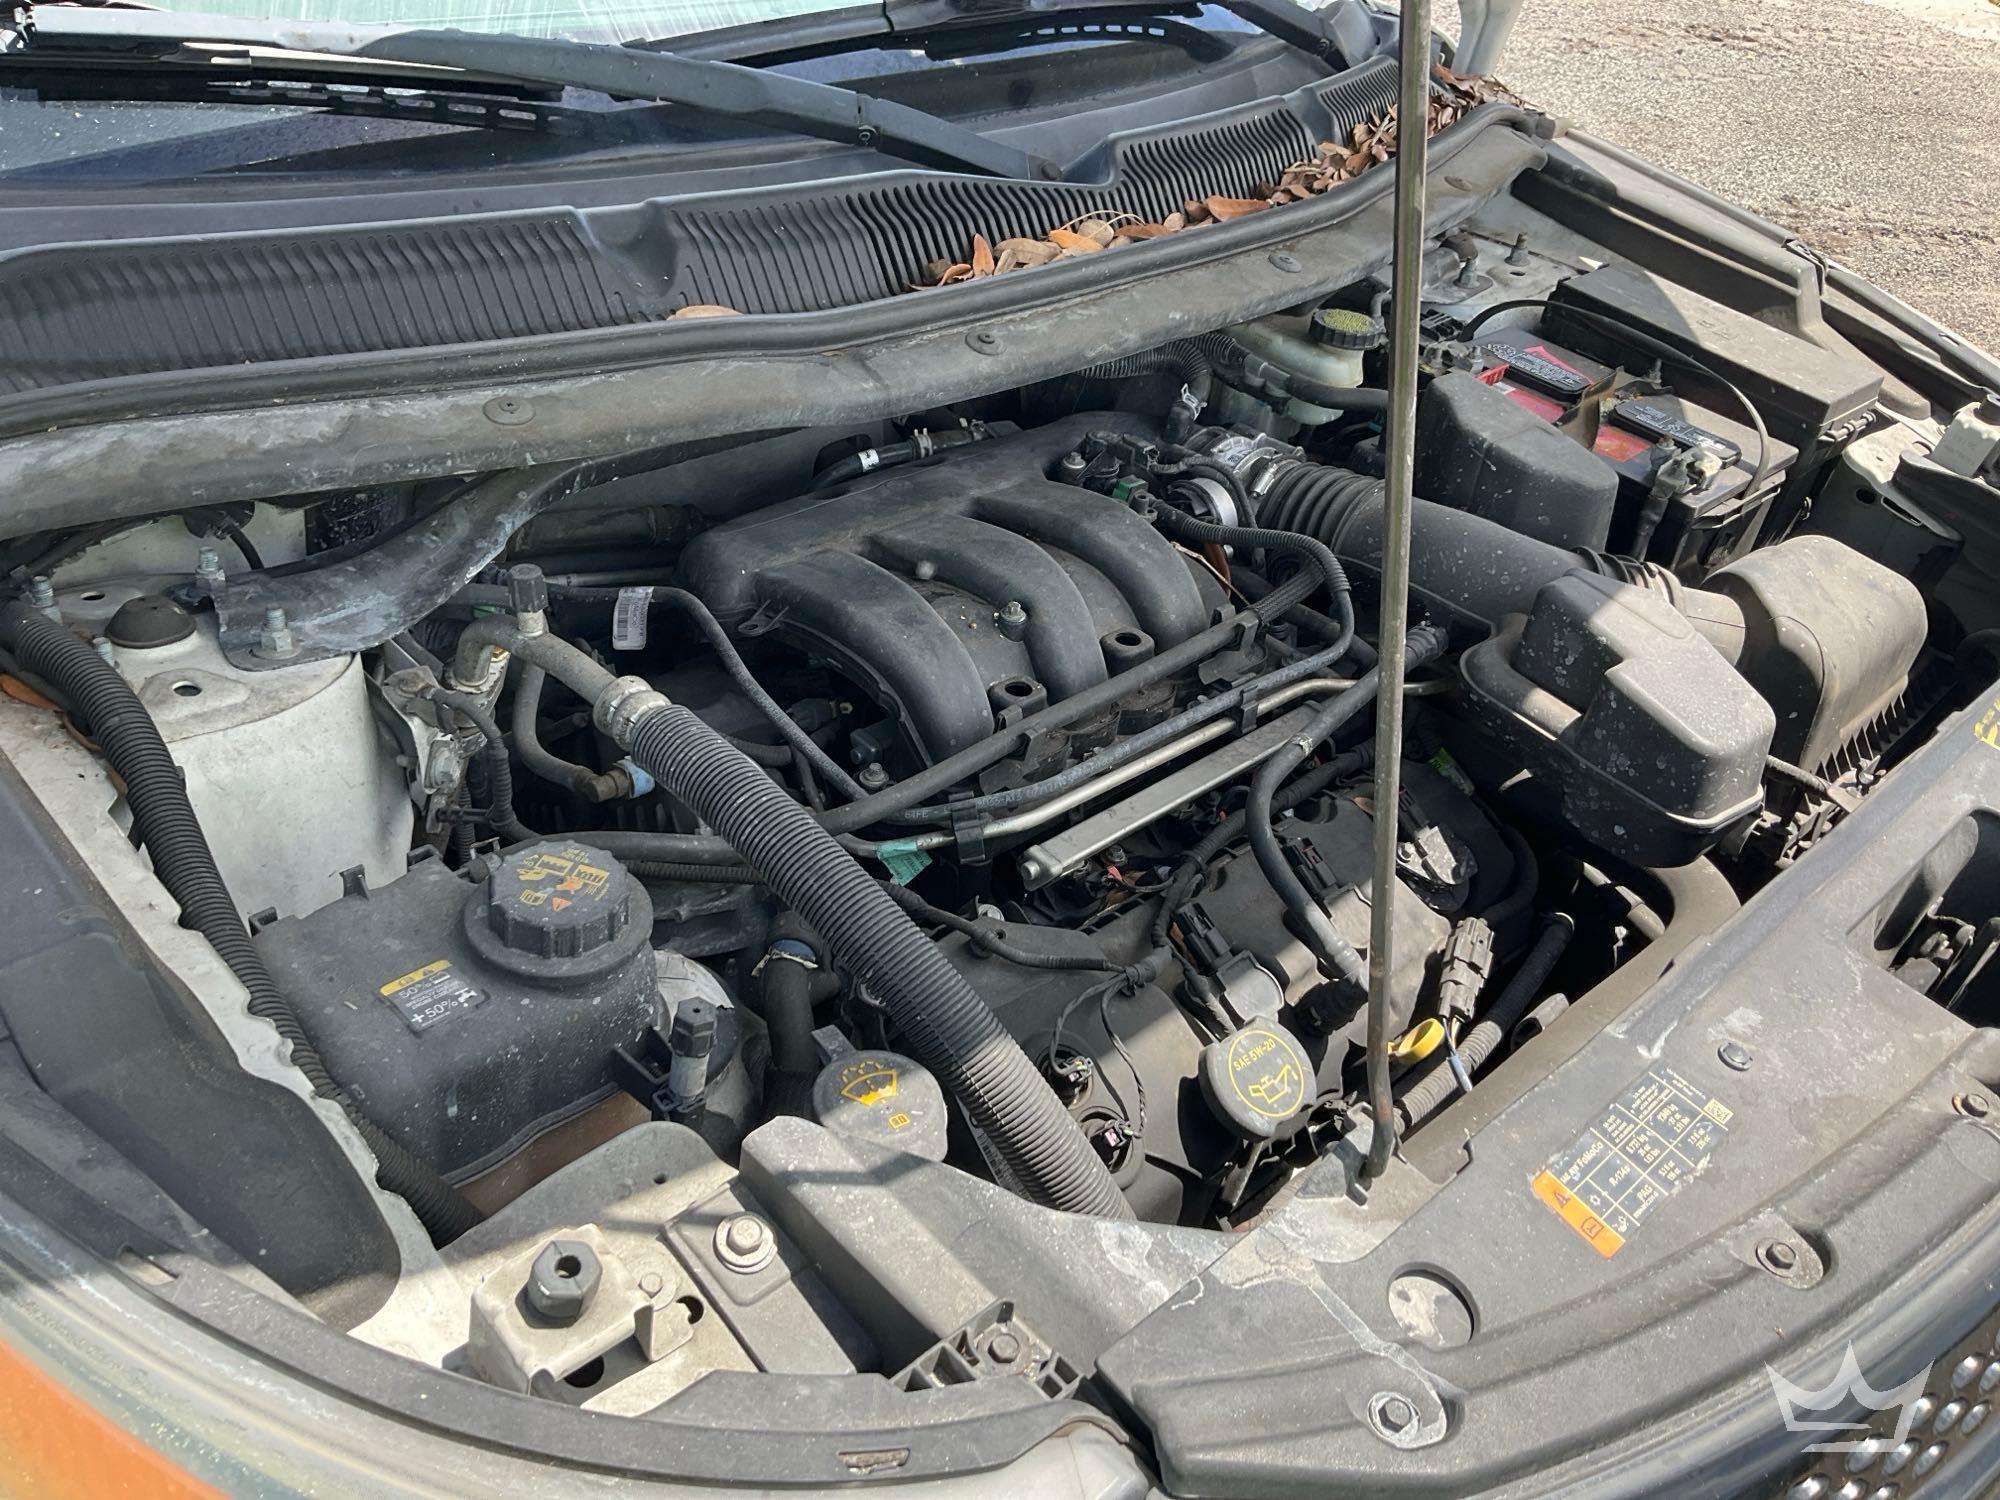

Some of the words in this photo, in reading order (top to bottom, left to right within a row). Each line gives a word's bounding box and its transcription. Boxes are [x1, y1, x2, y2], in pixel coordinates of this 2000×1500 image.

[1233, 1055, 1251, 1071] SAE
[1249, 1038, 1276, 1061] 5W-20
[1577, 1141, 1604, 1169] FoMoCo
[1609, 1165, 1631, 1187] R-134a
[1637, 1184, 1653, 1201] PAG
